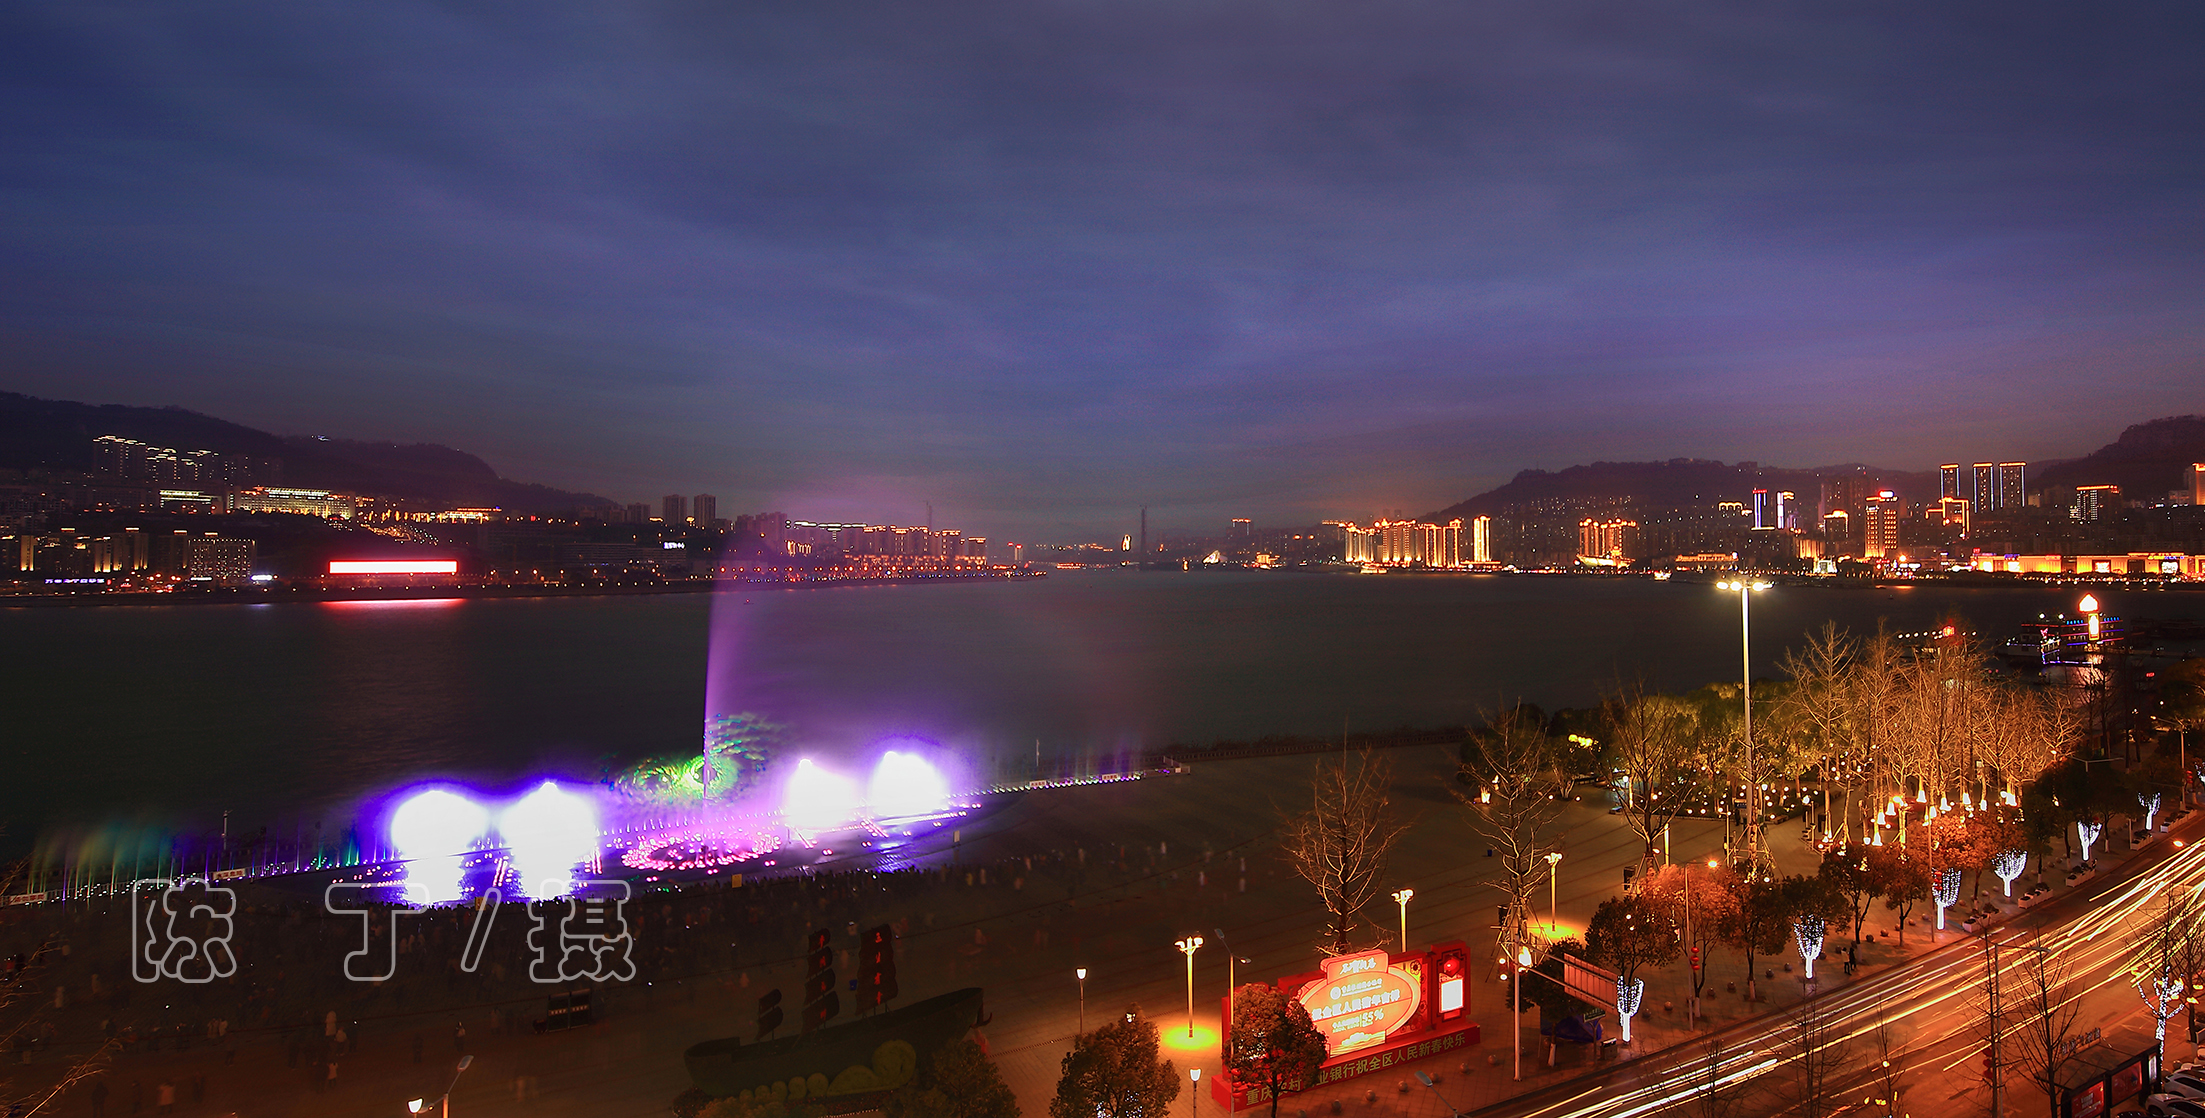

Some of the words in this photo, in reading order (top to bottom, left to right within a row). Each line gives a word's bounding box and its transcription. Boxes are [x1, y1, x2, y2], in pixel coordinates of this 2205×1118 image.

[1246, 1032, 1466, 1106] 重庆农村业银行祝全区人民新春快乐
